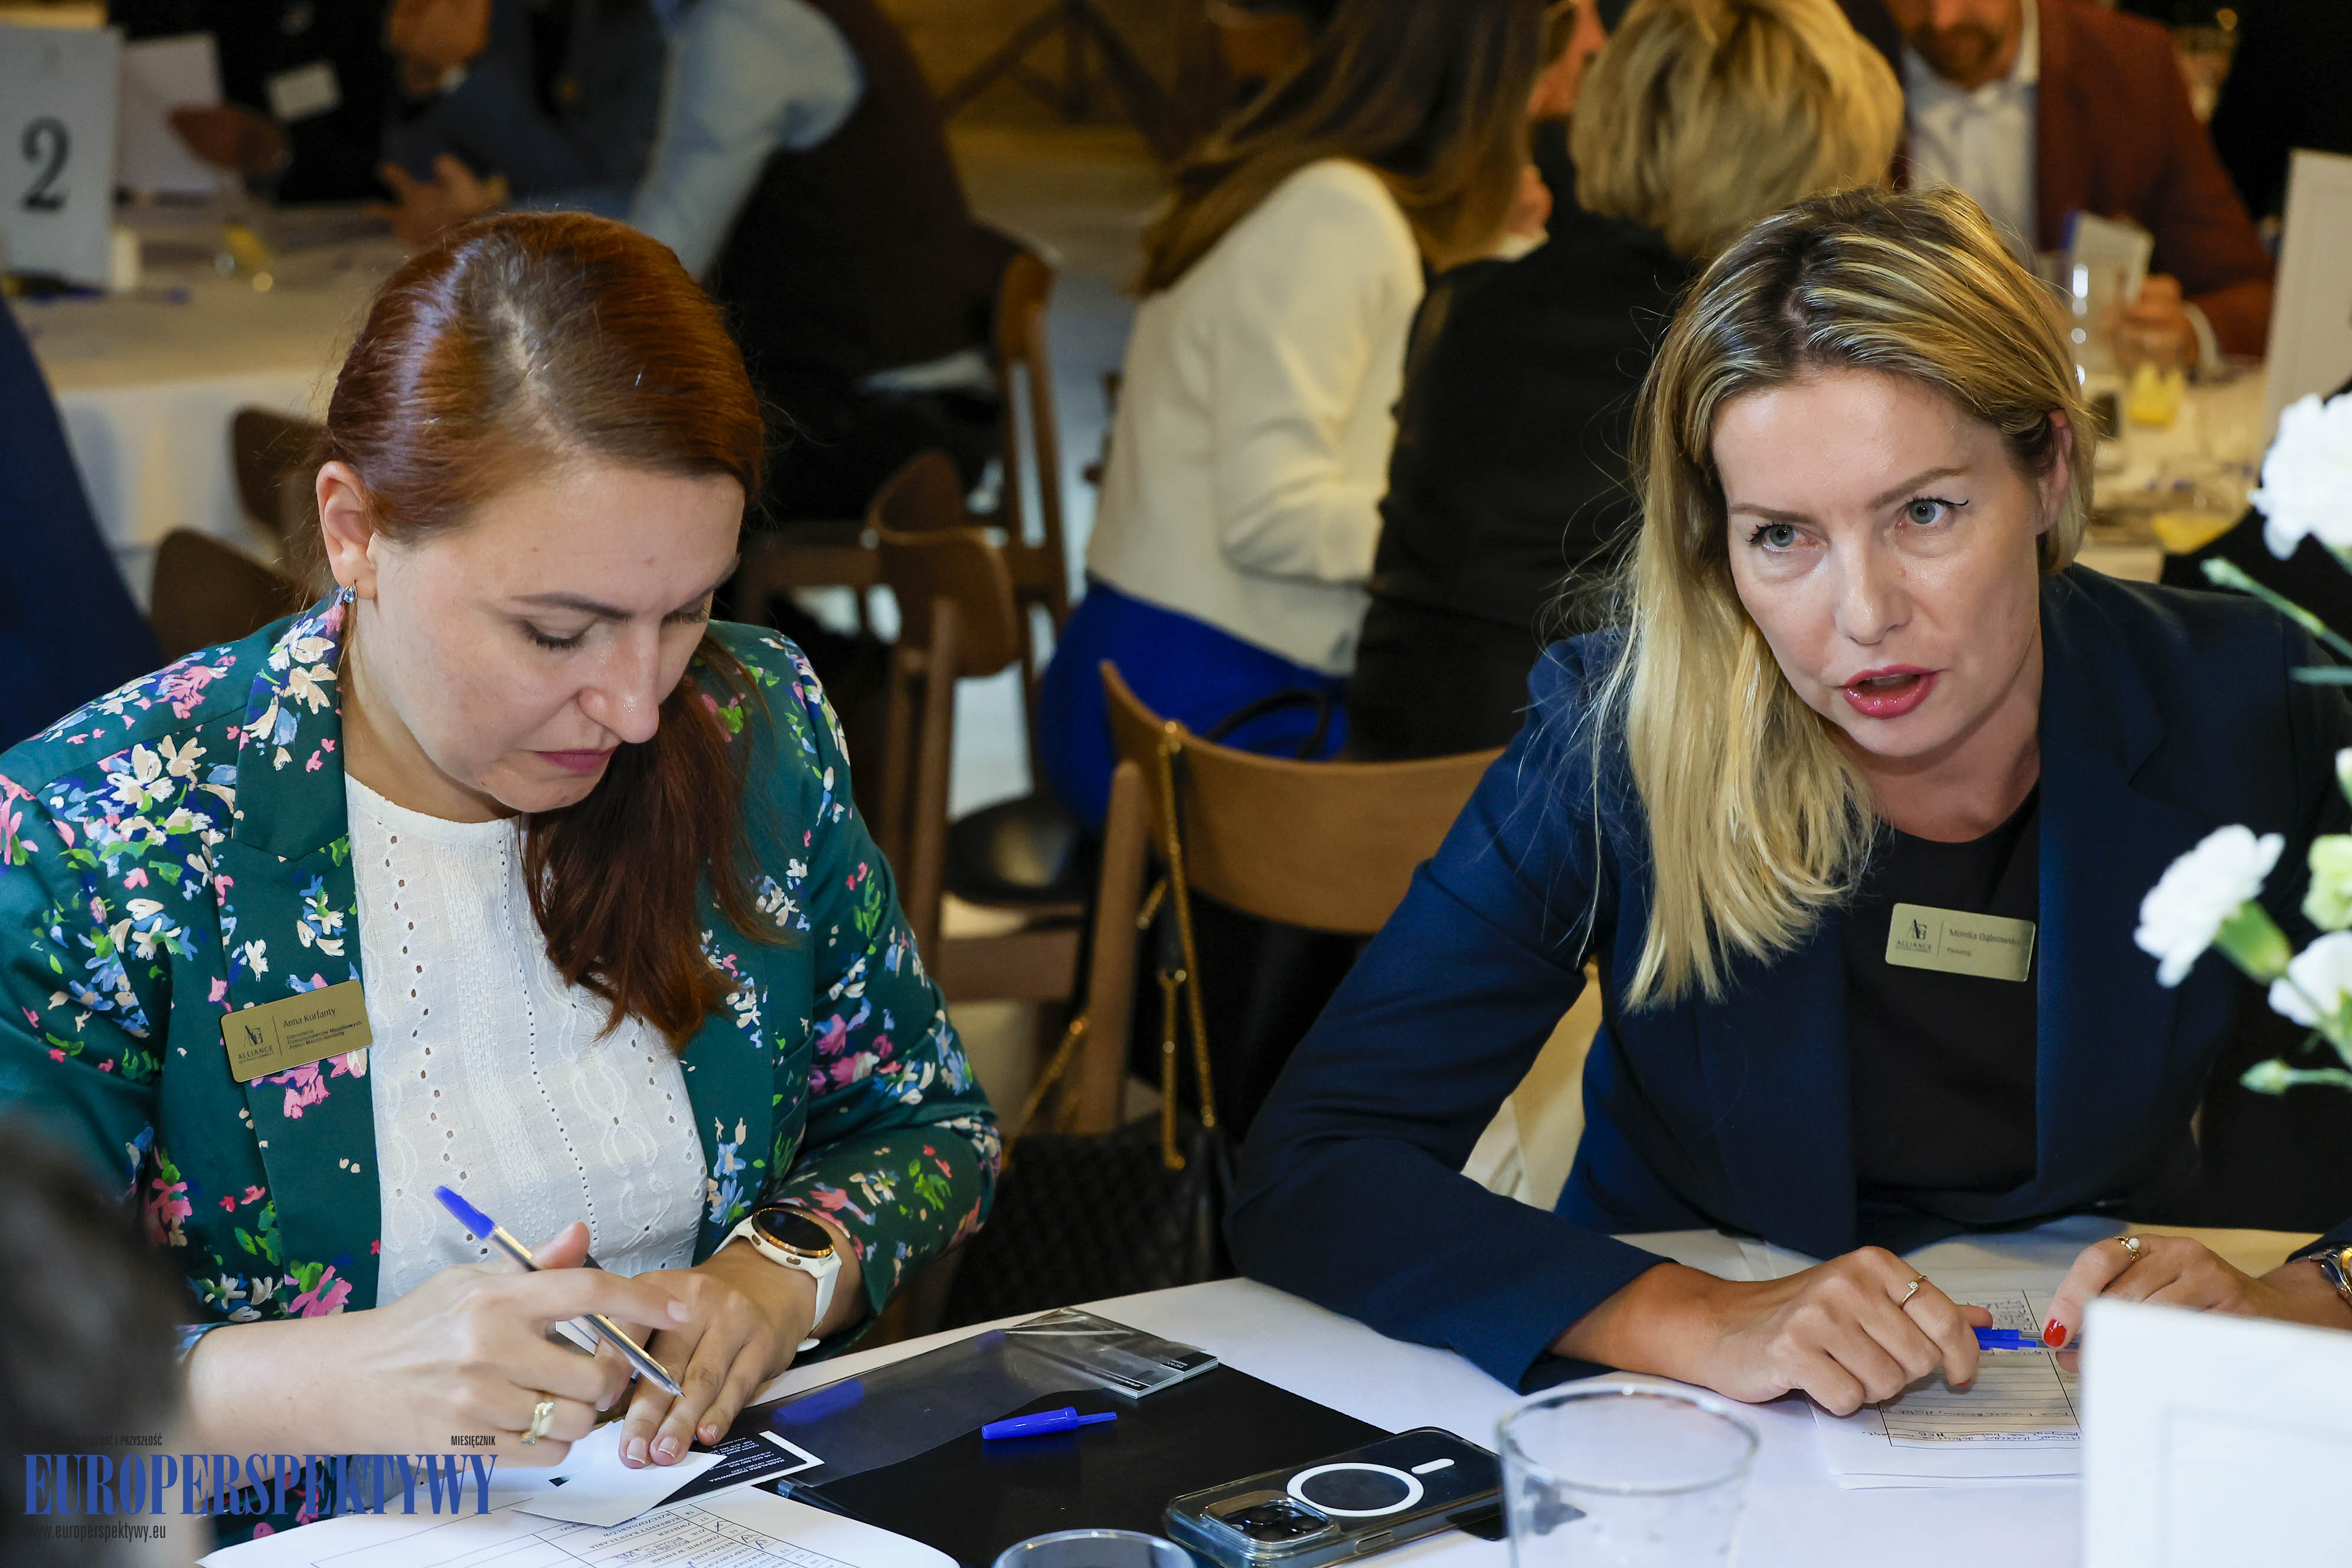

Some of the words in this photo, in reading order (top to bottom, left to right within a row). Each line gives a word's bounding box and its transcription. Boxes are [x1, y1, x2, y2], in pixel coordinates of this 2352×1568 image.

[21, 117, 70, 213] 2
[1949, 929, 1977, 940] Monika
[283, 1017, 302, 1028] Anna
[303, 1007, 336, 1023] Korfanty
[238, 1044, 273, 1059] ALLIANCE
[589, 1531, 639, 1549] KANCELARIA
